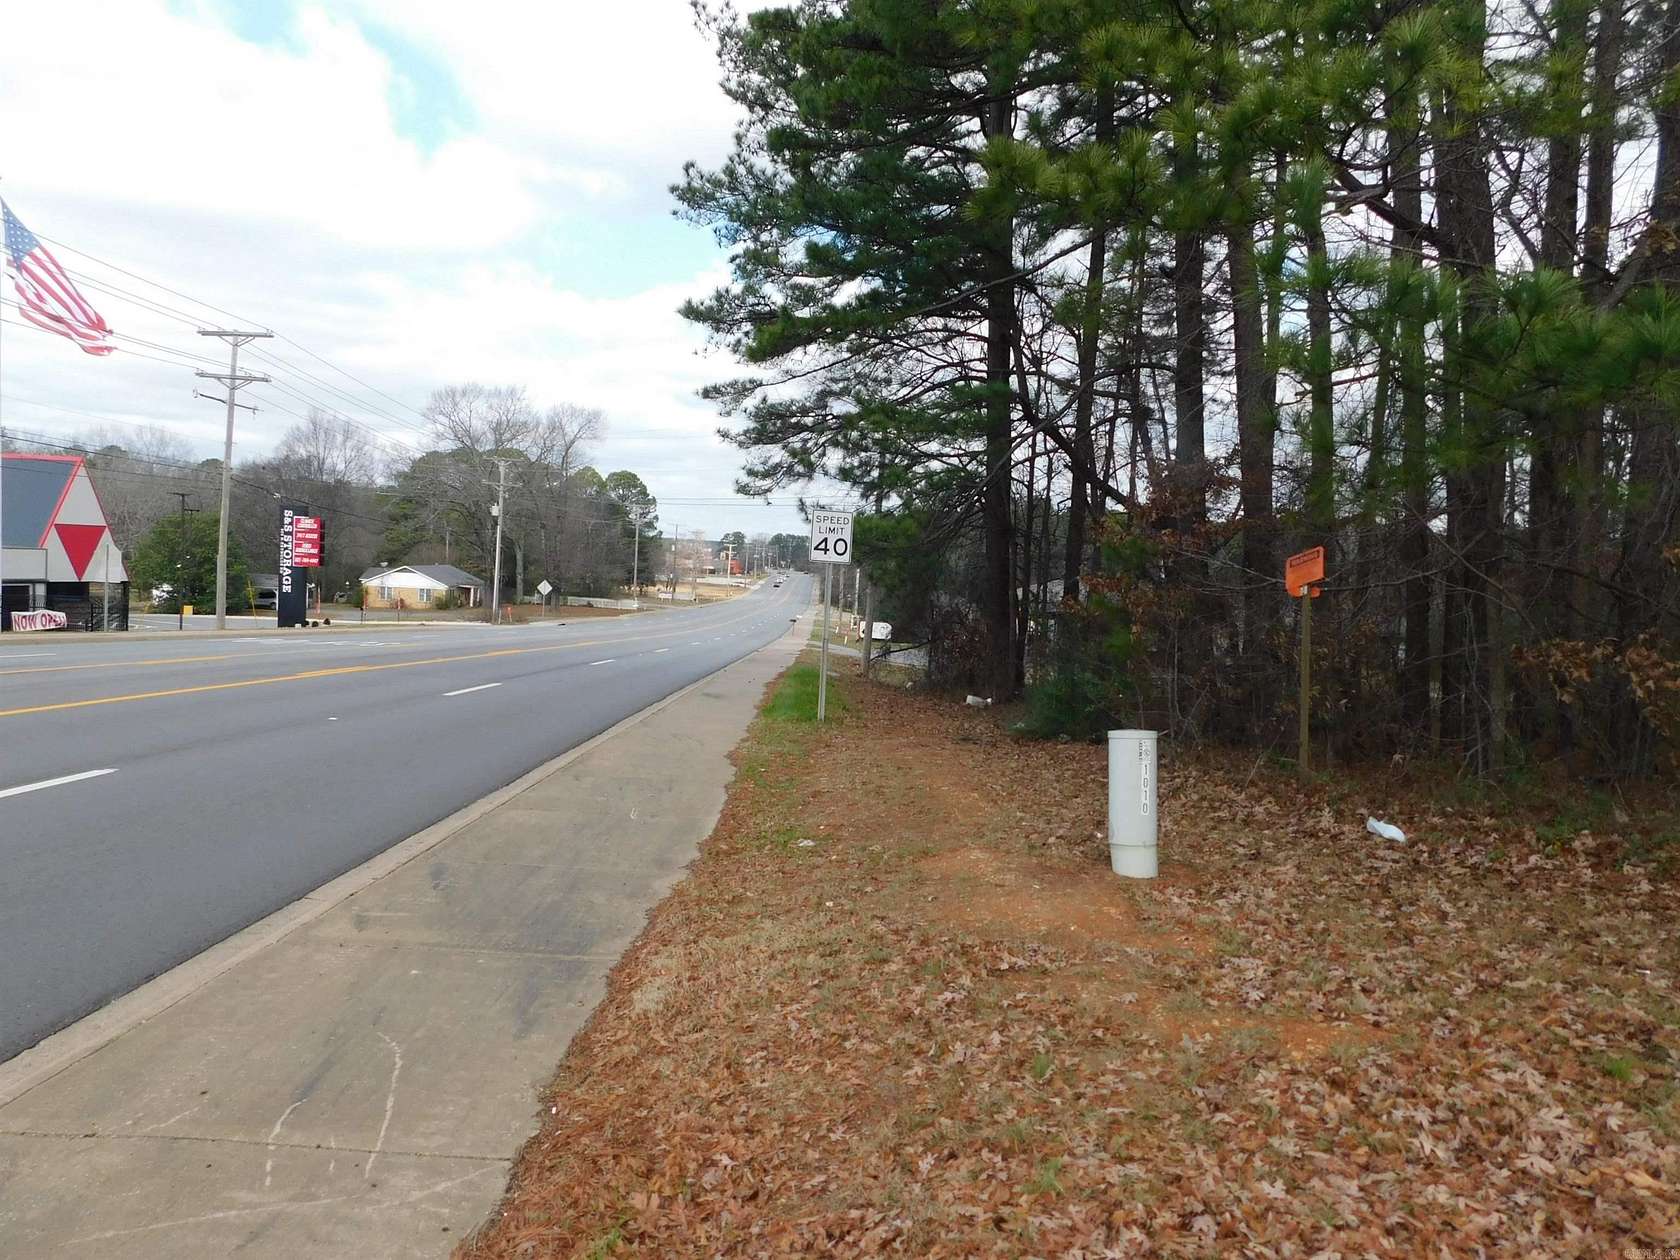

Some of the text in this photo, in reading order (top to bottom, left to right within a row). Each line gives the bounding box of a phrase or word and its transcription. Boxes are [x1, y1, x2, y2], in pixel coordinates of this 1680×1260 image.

[283, 509, 293, 532] S&S
[815, 515, 850, 525] SPEED
[818, 526, 845, 535] LIMIT
[813, 537, 848, 556] 40
[282, 535, 292, 593] STORAGE
[14, 614, 37, 630] NOW
